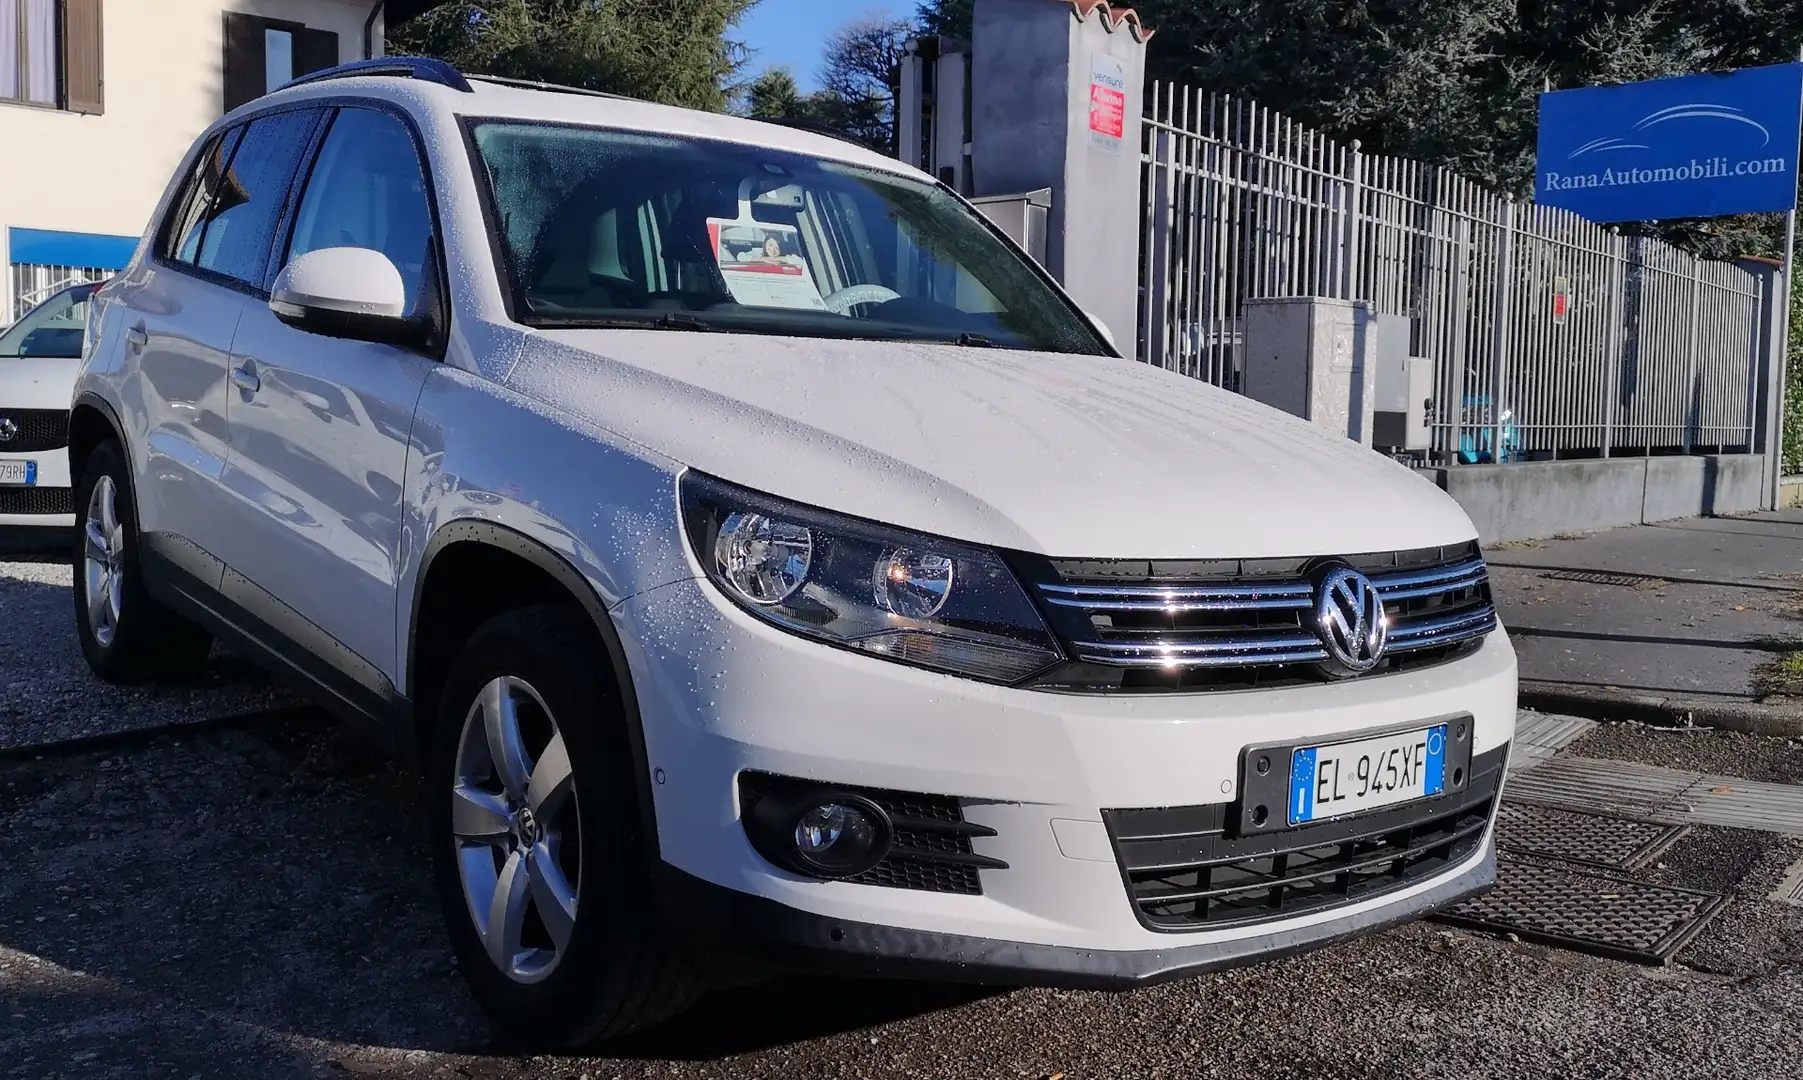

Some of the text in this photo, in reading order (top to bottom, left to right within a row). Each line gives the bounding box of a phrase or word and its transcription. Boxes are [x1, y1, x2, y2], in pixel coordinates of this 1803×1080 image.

[1093, 71, 1124, 88] verisure
[1544, 156, 1786, 191] RanaAutomobili.com
[1316, 742, 1426, 804] EL 945XF
